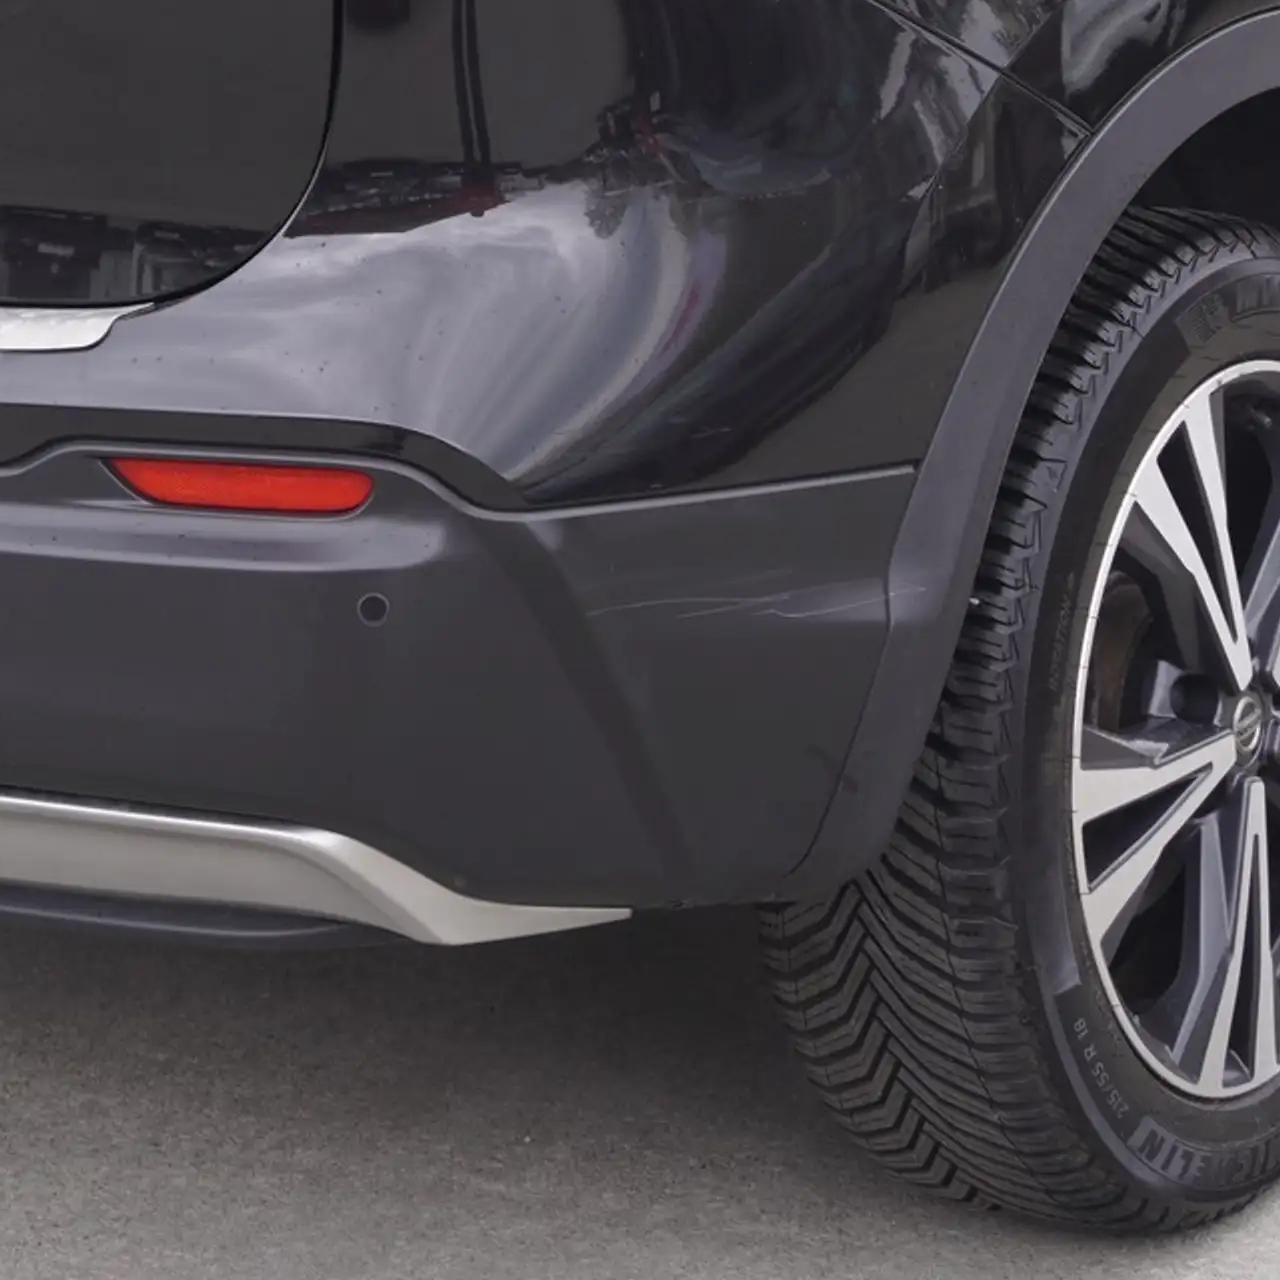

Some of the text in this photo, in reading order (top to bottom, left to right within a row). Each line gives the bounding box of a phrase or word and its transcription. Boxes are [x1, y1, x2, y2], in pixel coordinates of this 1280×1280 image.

[1073, 1018, 1129, 1119] 215/55 R 18
